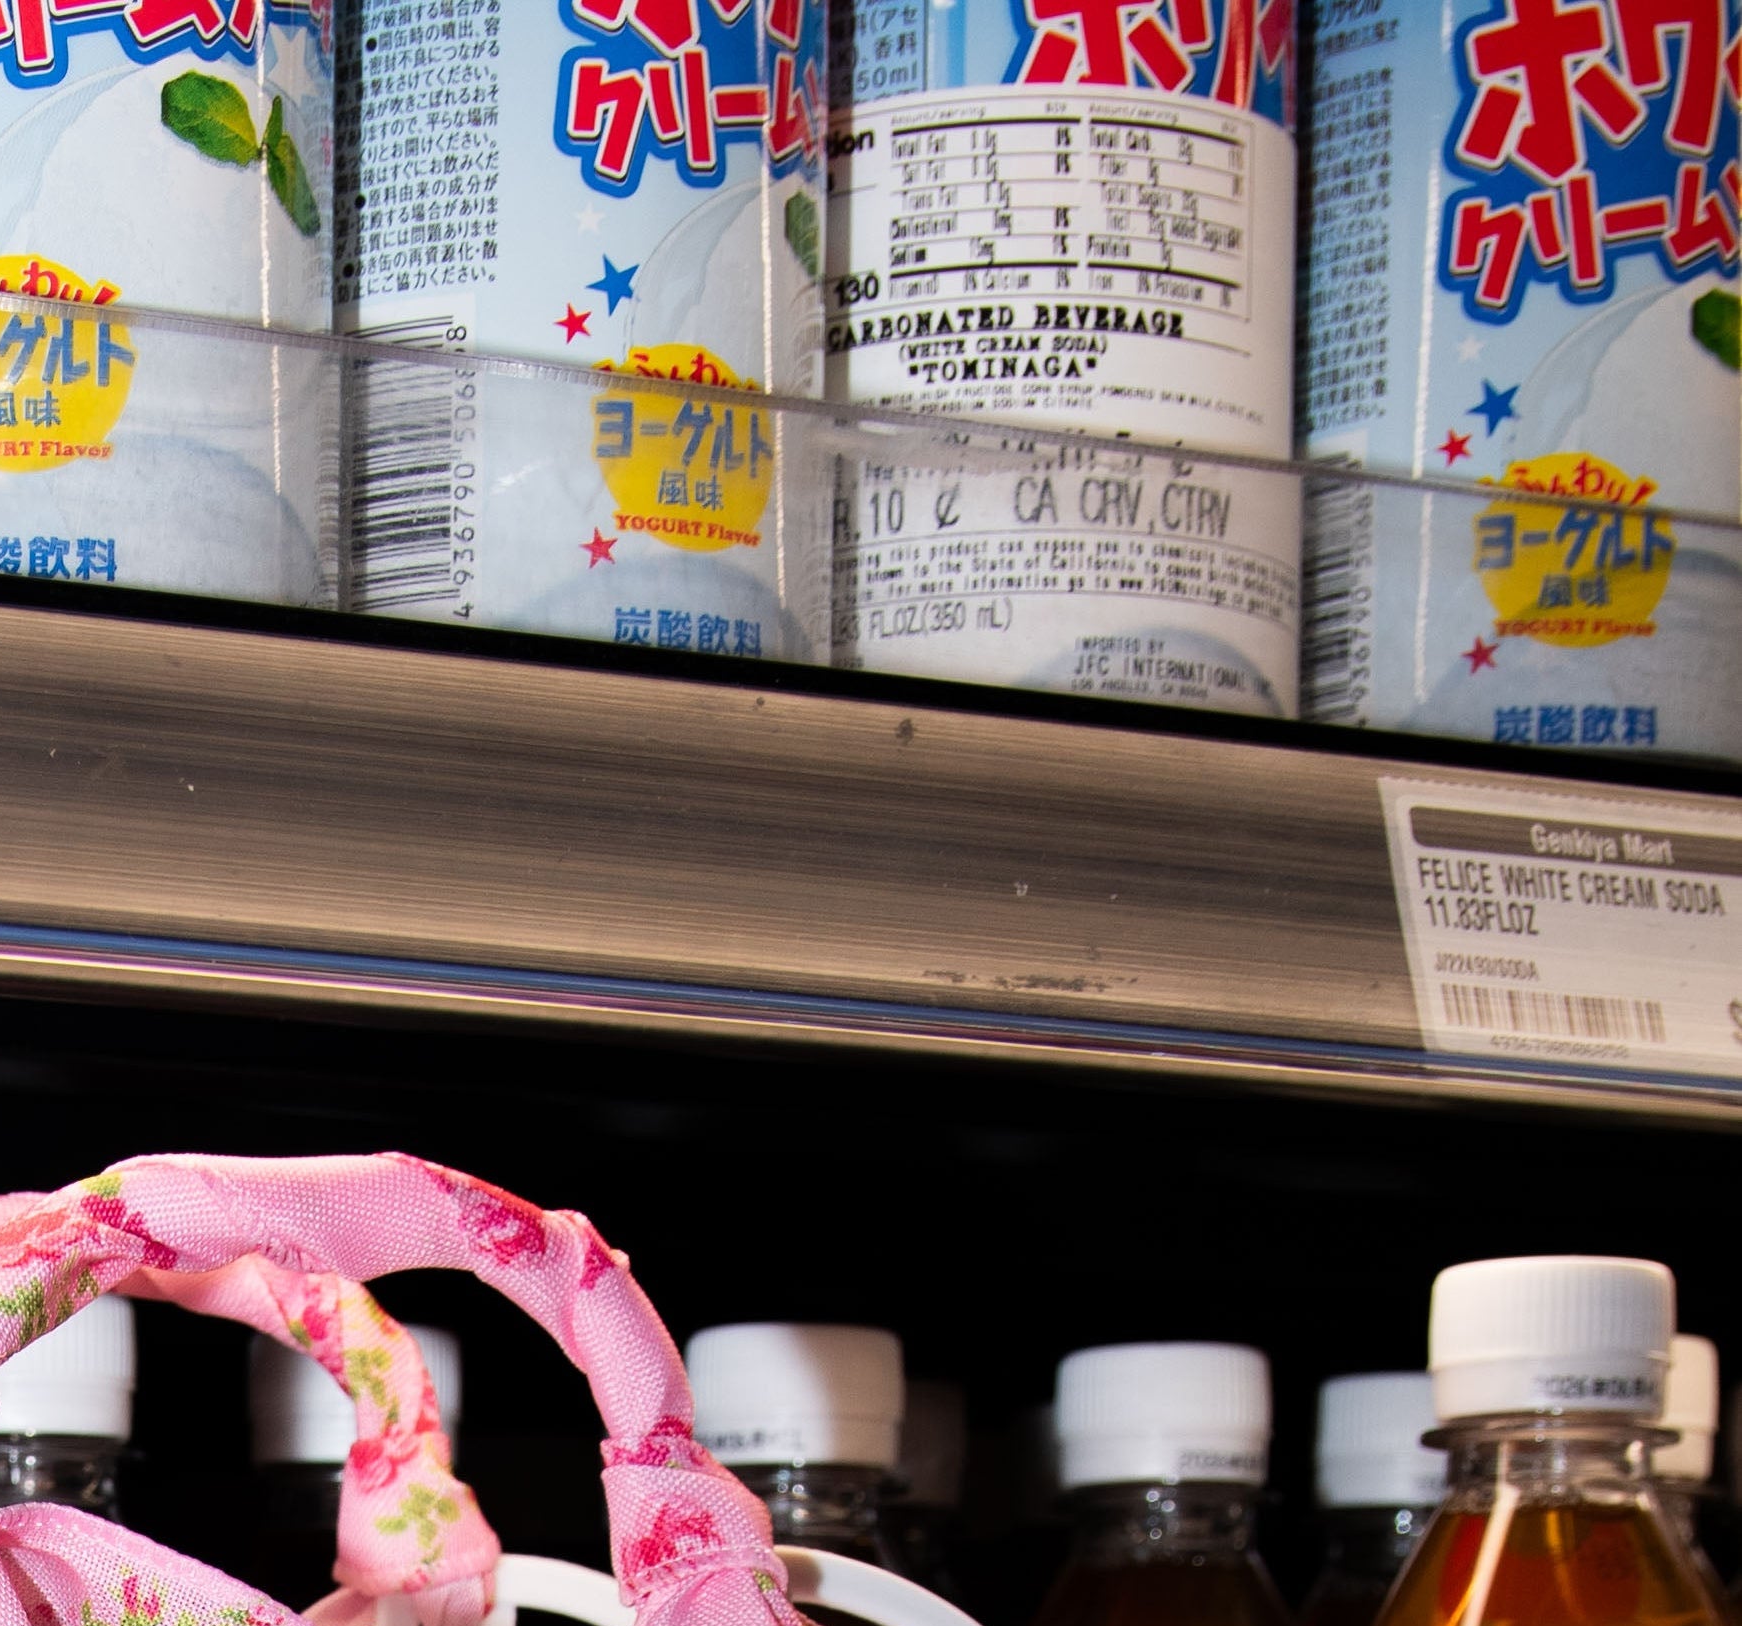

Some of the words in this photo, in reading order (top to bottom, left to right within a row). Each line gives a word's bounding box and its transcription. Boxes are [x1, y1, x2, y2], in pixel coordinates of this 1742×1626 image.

[827, 305, 1014, 351] CARBONATED
[1034, 303, 1184, 338] BEVERAGE
[976, 335, 1043, 354] CREAM
[39, 441, 113, 460] Flavor
[658, 471, 725, 511] 風味
[1014, 476, 1057, 524] CA
[616, 513, 702, 538] YOGURT
[705, 522, 761, 547] Flavor
[614, 607, 763, 657] 炭酸飲料
[1073, 656, 1110, 678] JFC
[1530, 822, 1619, 864] Genkiya
[1623, 832, 1676, 866] Mart
[1417, 856, 1493, 896] FELICE
[1499, 863, 1573, 902] WHITE
[1578, 870, 1659, 910] CREAM
[1663, 877, 1727, 917] SODA
